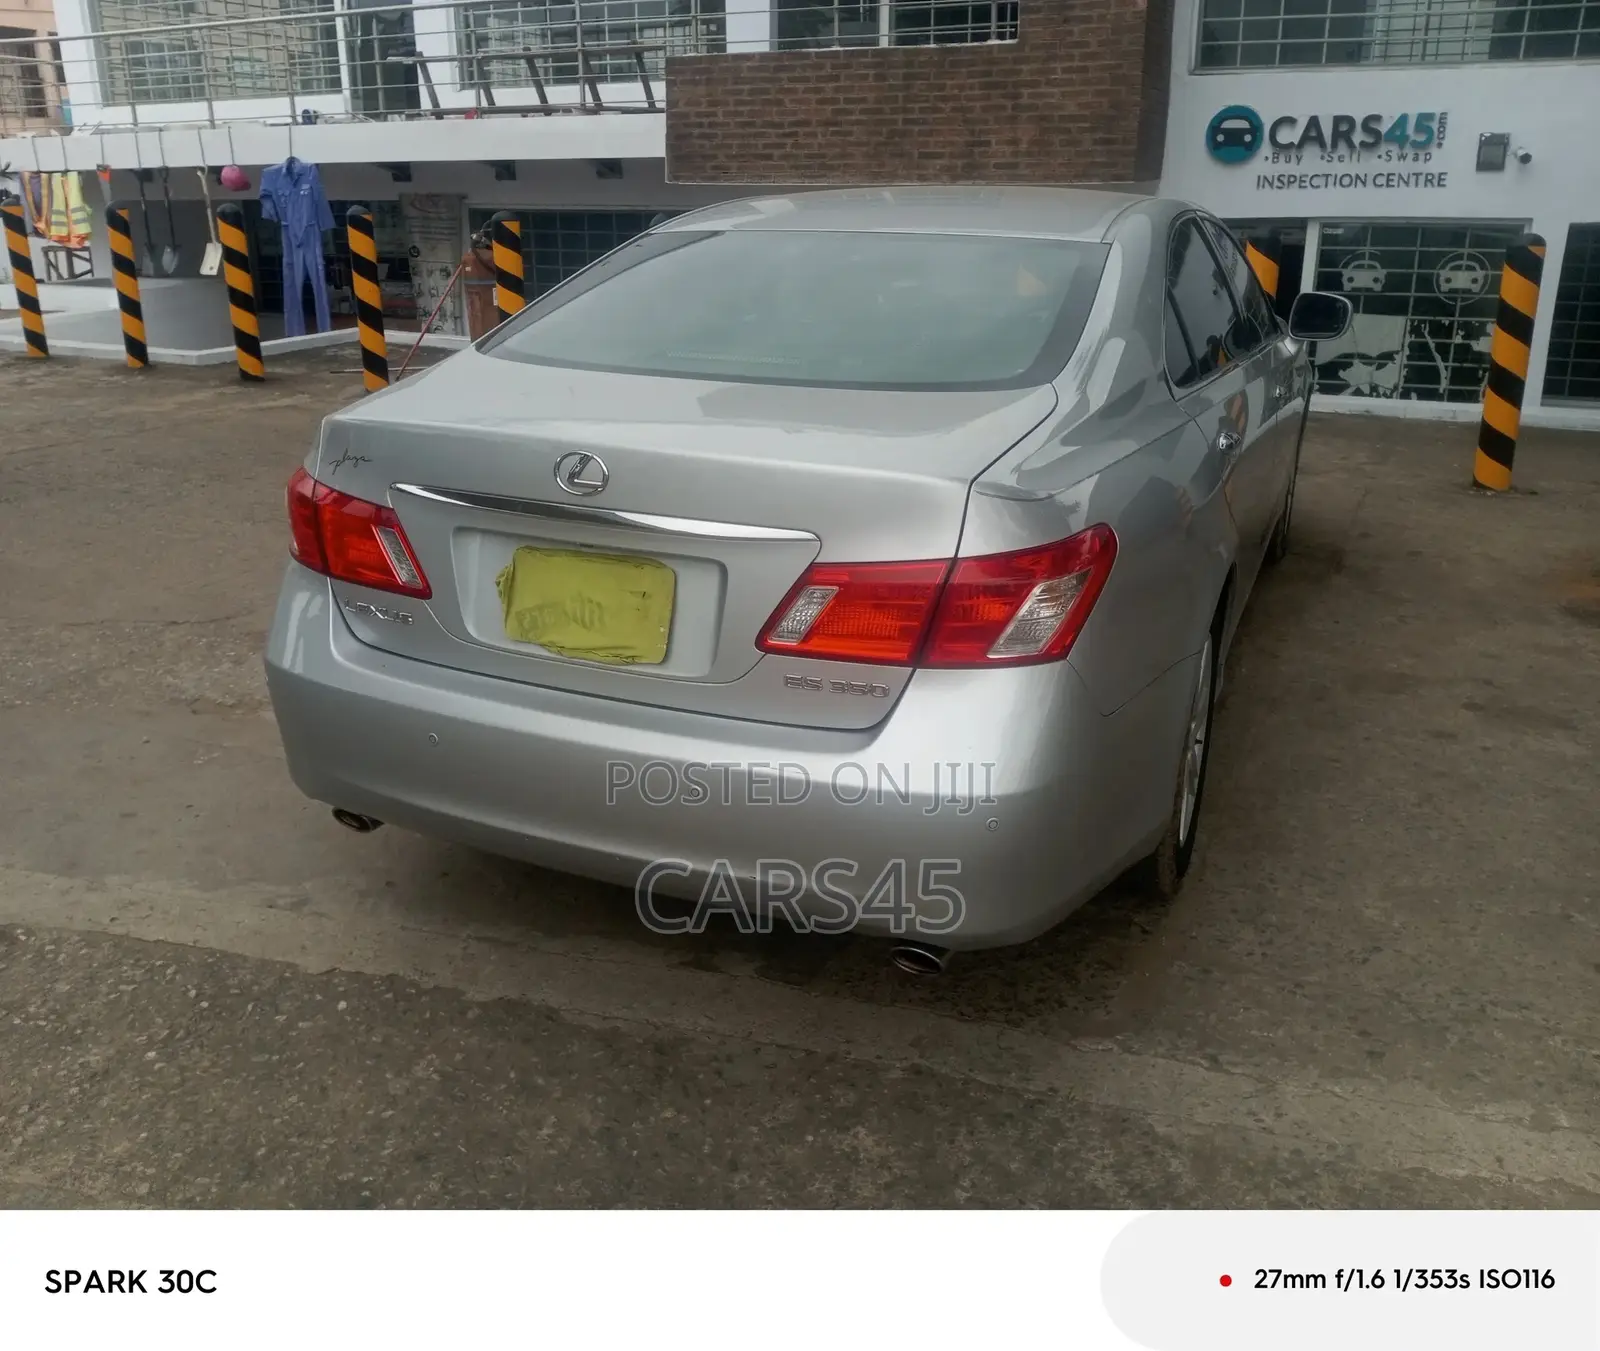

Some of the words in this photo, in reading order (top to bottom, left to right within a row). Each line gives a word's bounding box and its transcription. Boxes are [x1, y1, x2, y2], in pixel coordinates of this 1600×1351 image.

[1268, 112, 1437, 151] CARS45
[1256, 173, 1368, 190] INSPECTION
[1372, 171, 1448, 189] CENTRE
[344, 596, 414, 626] LEXUS
[784, 673, 824, 692] ES
[828, 679, 890, 698] 350
